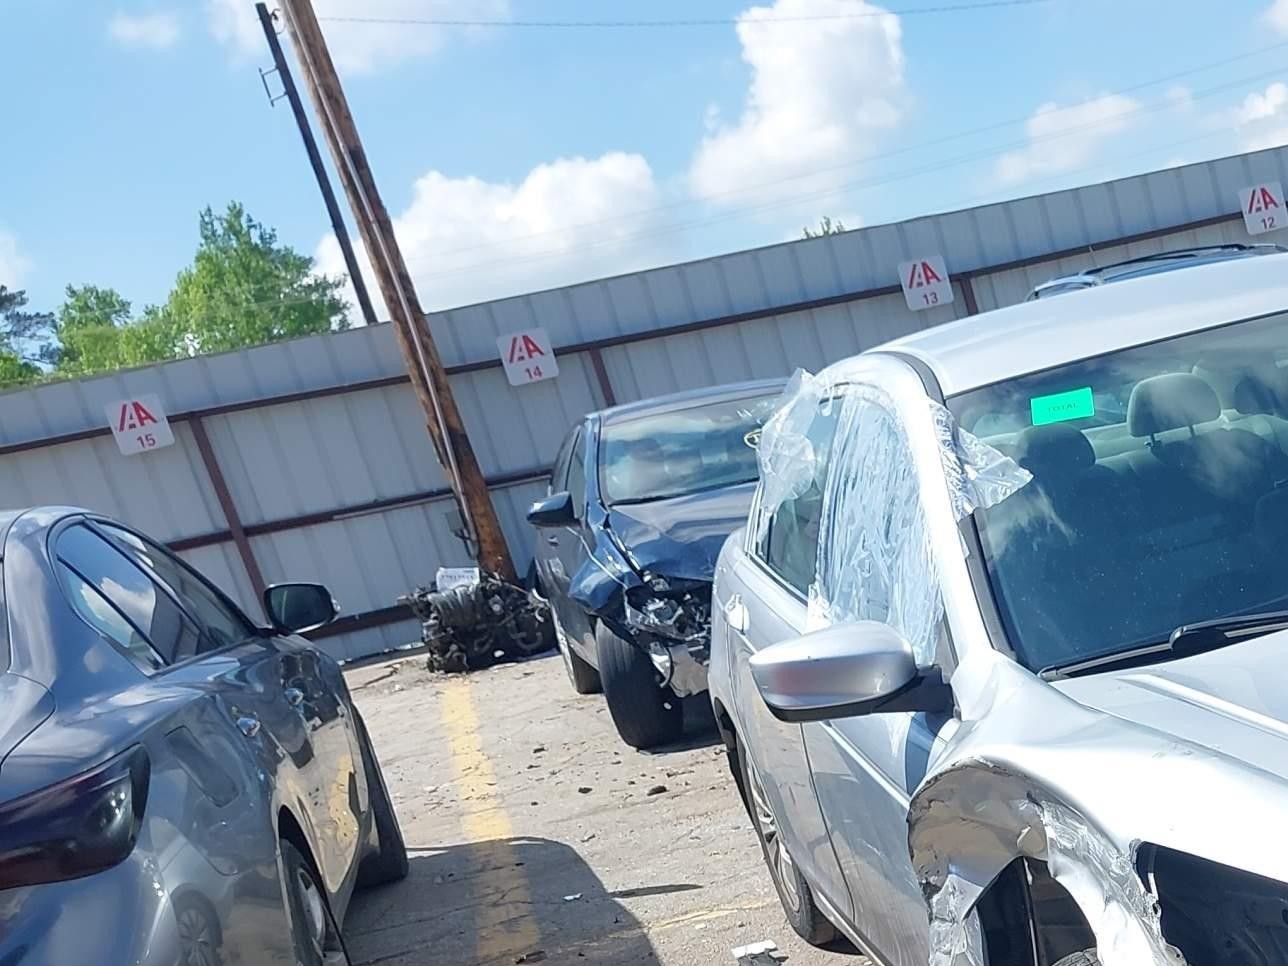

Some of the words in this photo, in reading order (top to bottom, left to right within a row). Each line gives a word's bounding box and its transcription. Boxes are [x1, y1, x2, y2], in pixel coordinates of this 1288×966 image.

[1261, 217, 1277, 229] 12
[923, 291, 938, 304] 13
[525, 365, 543, 379] 14
[136, 433, 157, 448] 15
